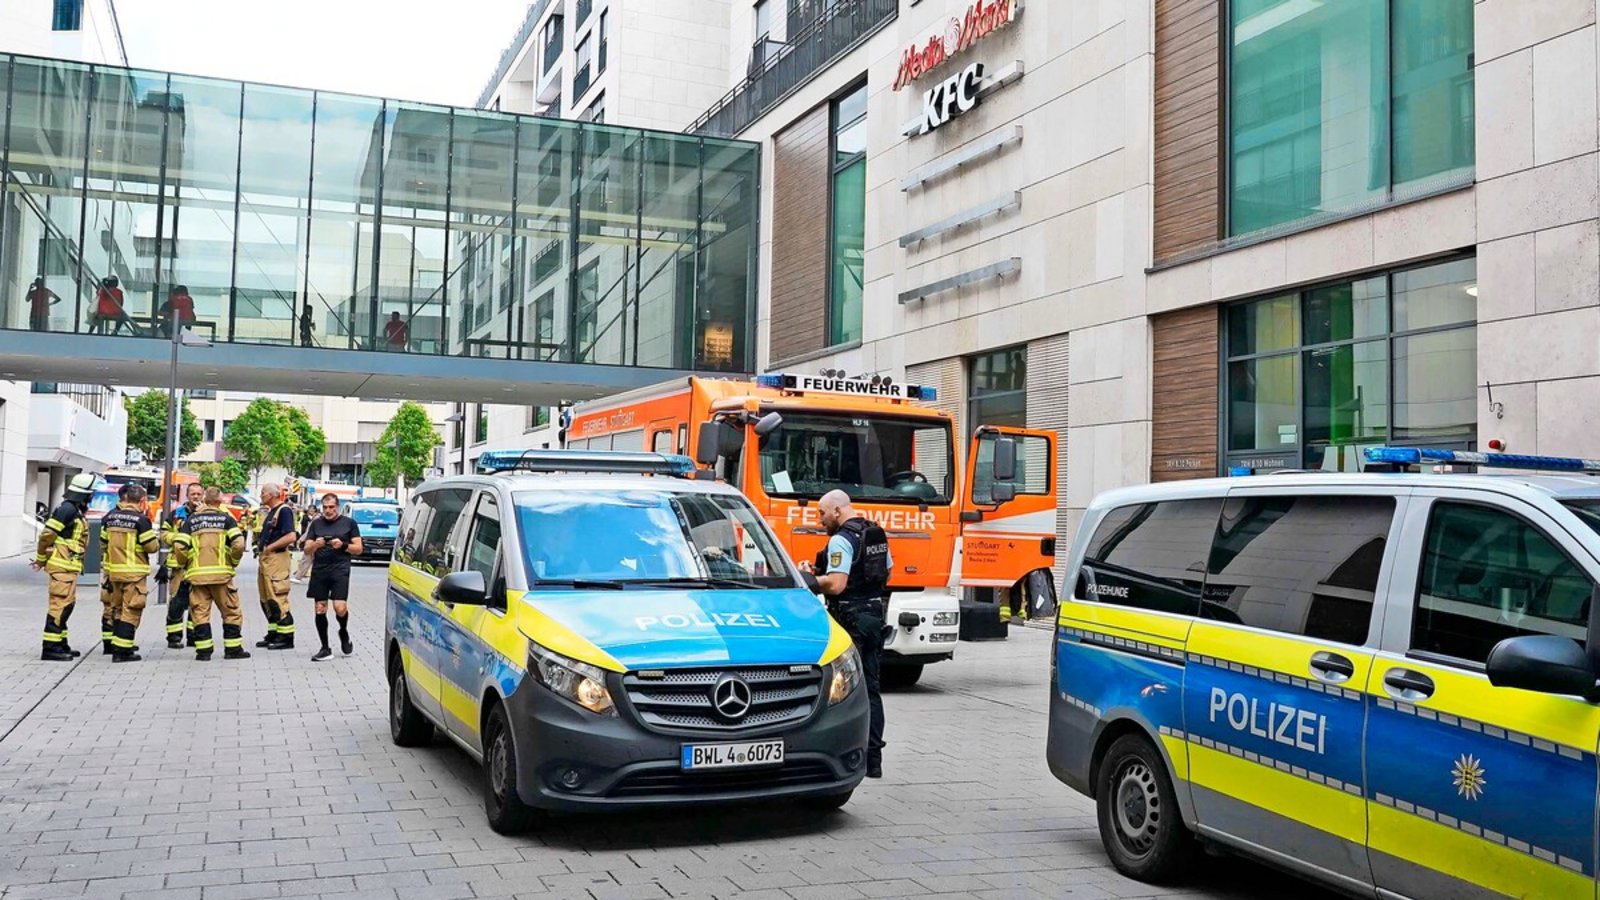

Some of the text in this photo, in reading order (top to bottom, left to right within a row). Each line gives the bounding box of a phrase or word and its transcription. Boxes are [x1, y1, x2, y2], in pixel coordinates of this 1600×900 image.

[892, 34, 945, 91] Media
[919, 63, 984, 135] KFC
[803, 378, 901, 397] FEUERWEHR
[866, 543, 889, 555] POLIZE
[1086, 583, 1129, 598] POLIZEIHUNDE
[634, 612, 781, 632] POLIZEI
[1210, 686, 1326, 755] POLIZEI
[694, 743, 782, 765] BWL 4 6073
